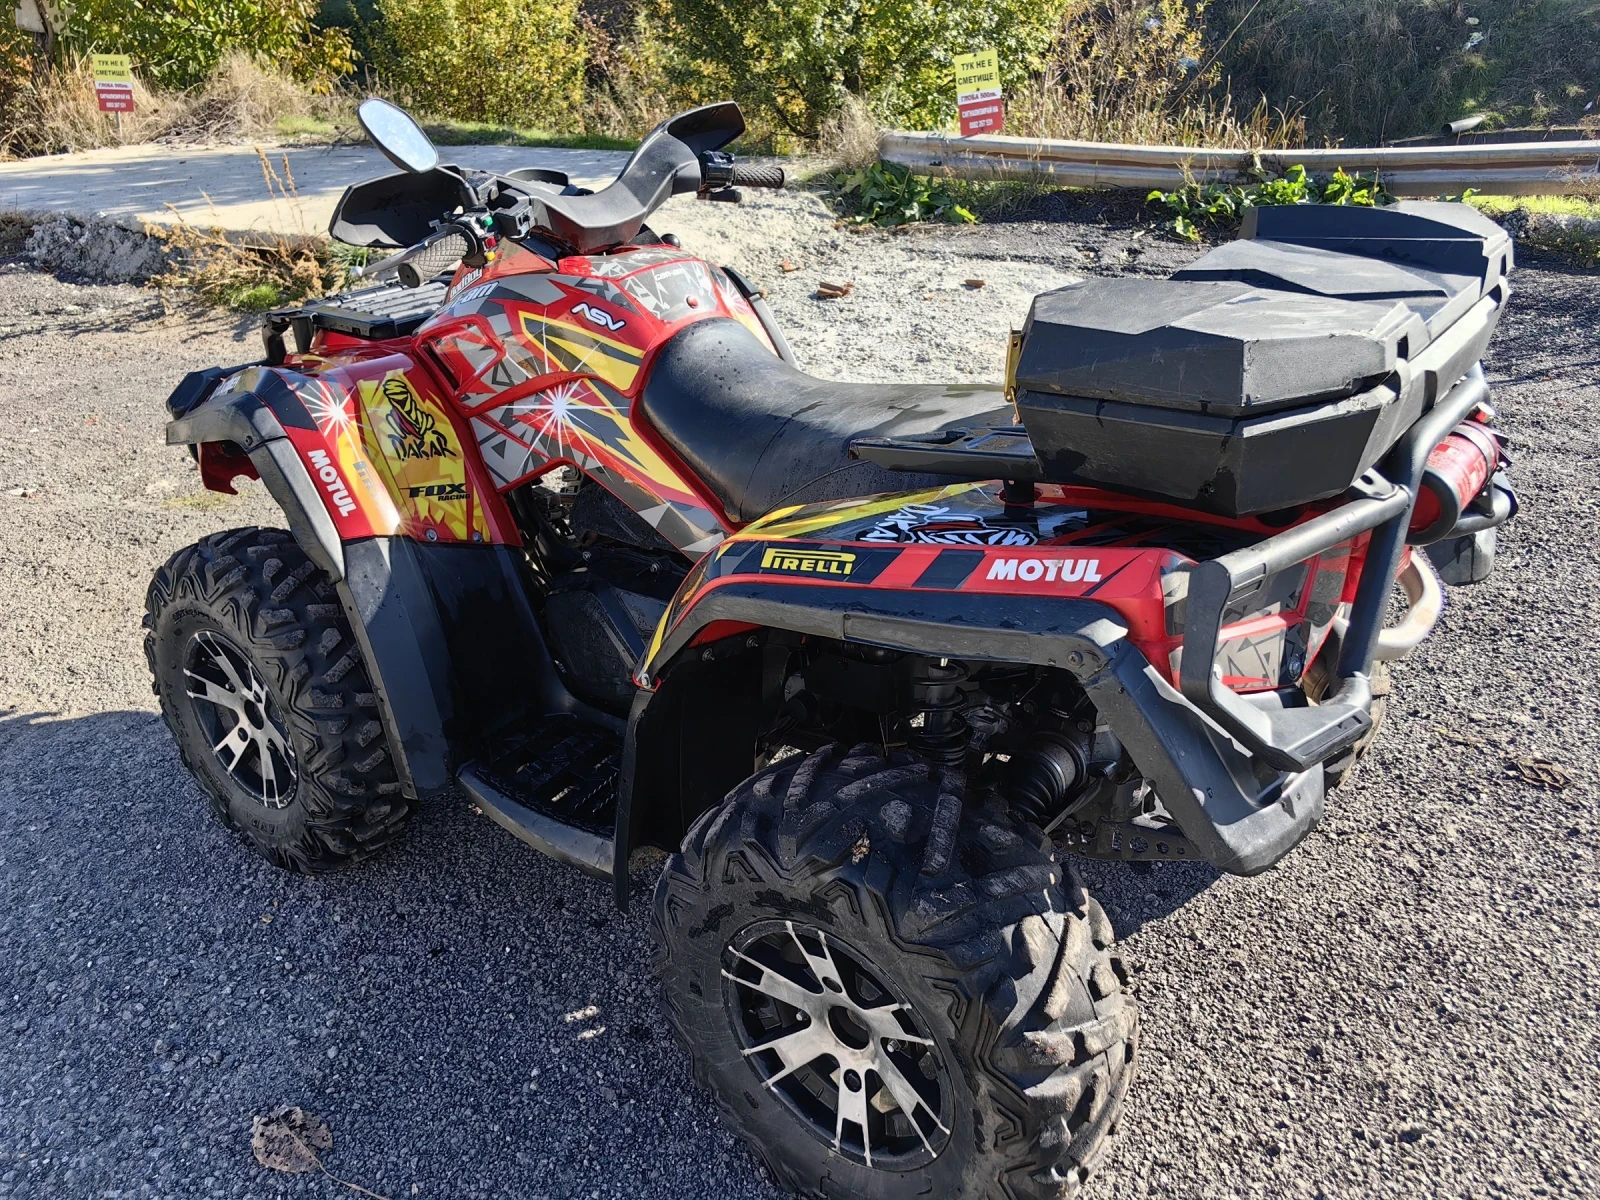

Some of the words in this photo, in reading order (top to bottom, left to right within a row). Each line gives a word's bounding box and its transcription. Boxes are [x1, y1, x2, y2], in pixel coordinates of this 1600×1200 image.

[961, 62, 974, 71] ТУК
[976, 60, 985, 68] НЕ
[987, 58, 992, 67] Е
[957, 72, 994, 85] СМЕТИЩЕ
[570, 302, 626, 331] ASV
[387, 429, 457, 461] DAKAR
[307, 449, 357, 518] MOTUL
[400, 482, 468, 499] FOX
[437, 493, 471, 501] RACING
[760, 547, 857, 575] PIRELLI
[985, 558, 1102, 583] MOTUL
